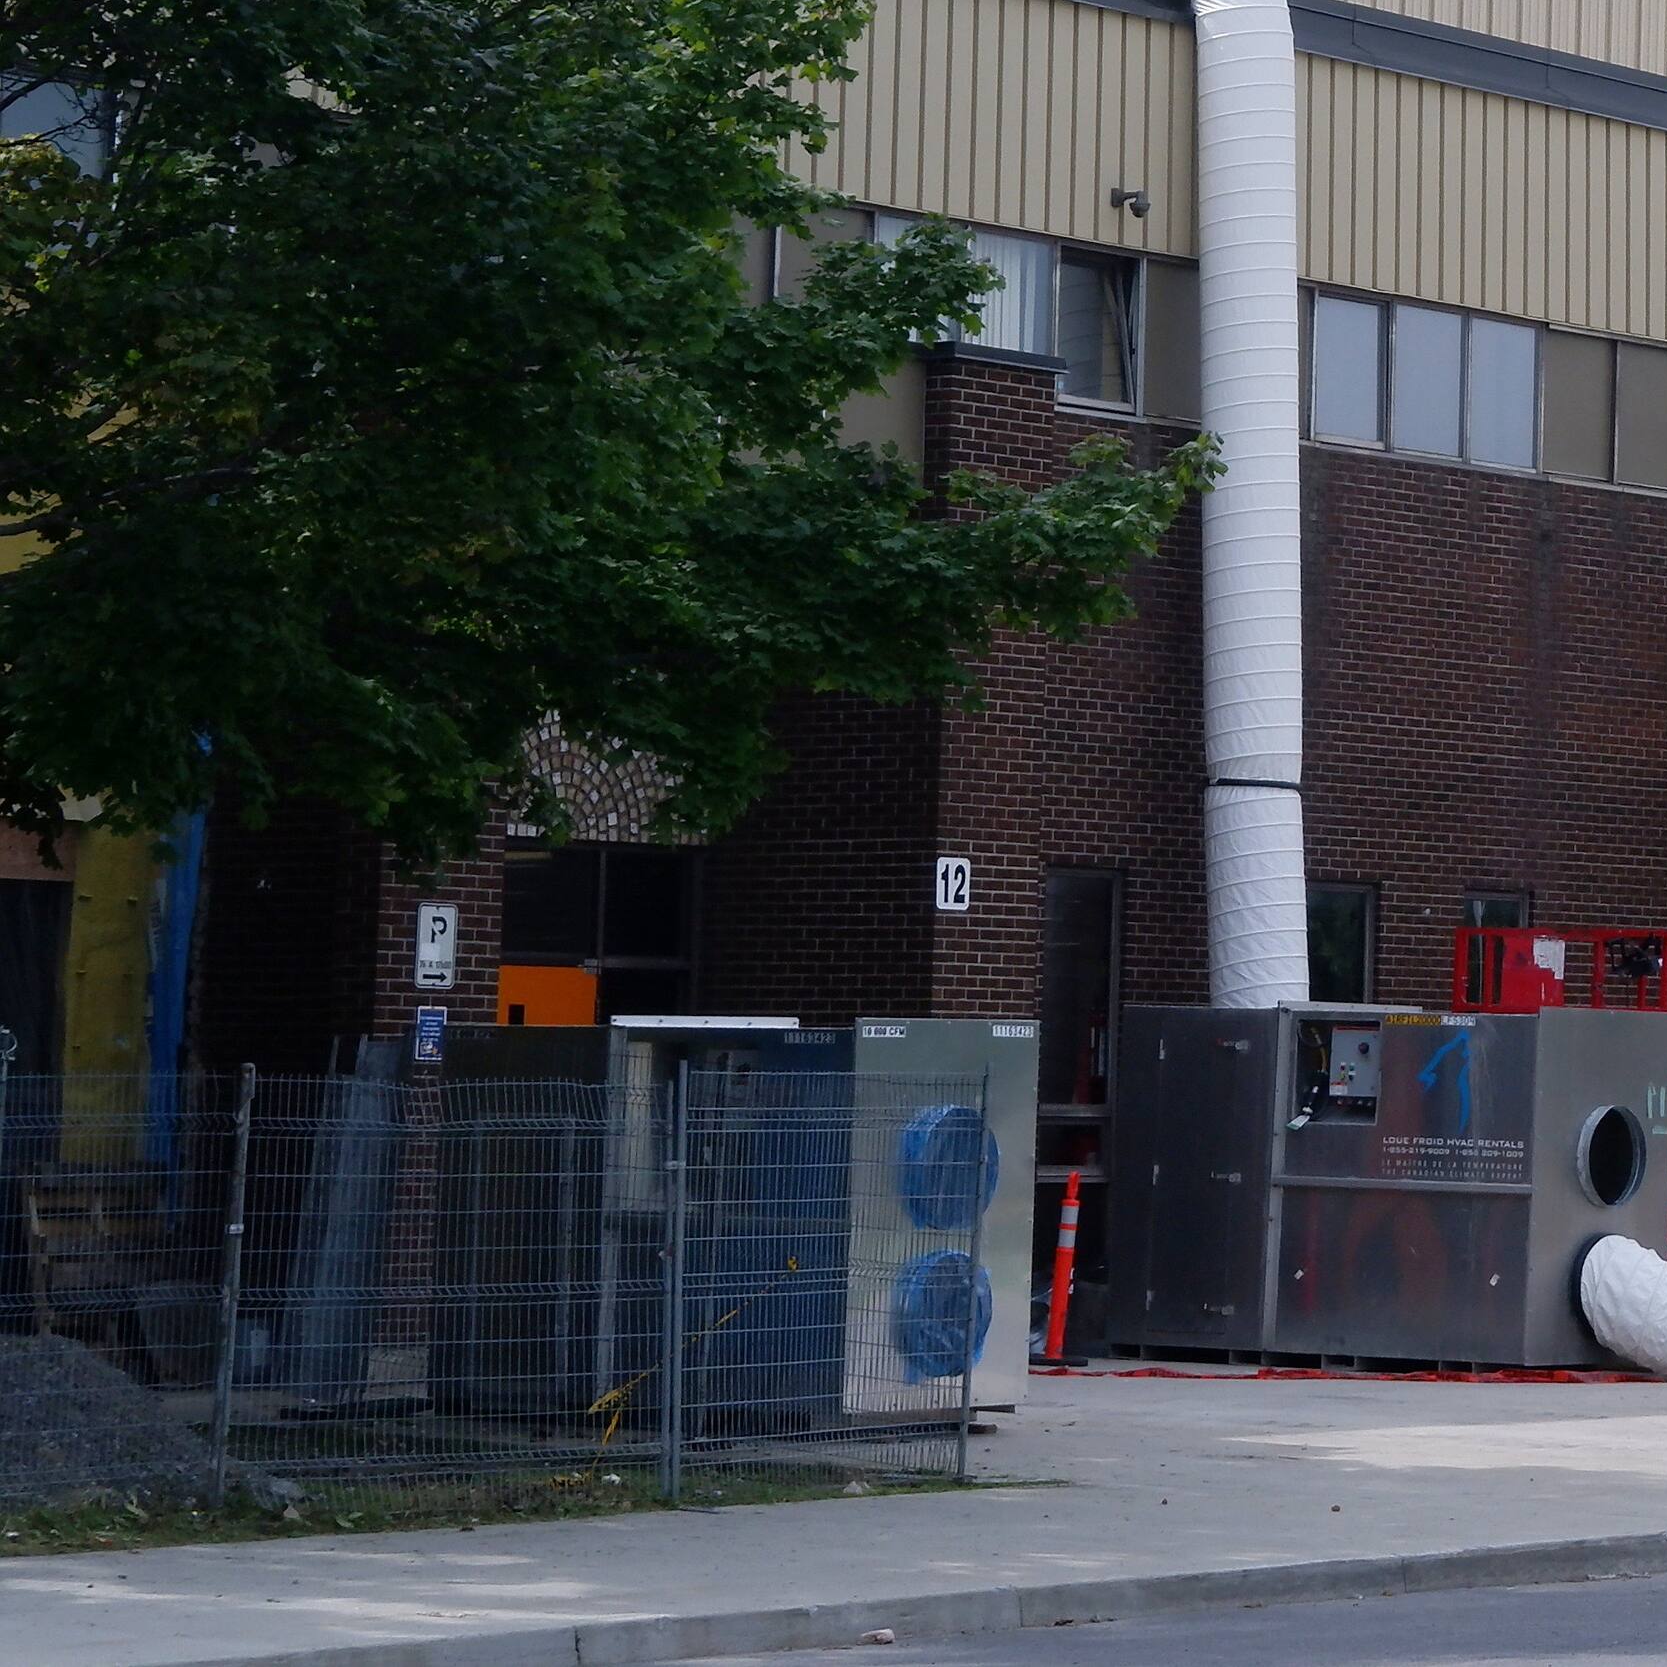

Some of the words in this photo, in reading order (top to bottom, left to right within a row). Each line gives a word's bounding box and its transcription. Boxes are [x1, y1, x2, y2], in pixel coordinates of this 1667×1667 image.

[941, 863, 966, 903] 12
[430, 916, 448, 943] P
[1413, 1137, 1443, 1145] FROID
[1447, 1138, 1474, 1147] HVAC
[1478, 1139, 1524, 1148] RENTALS
